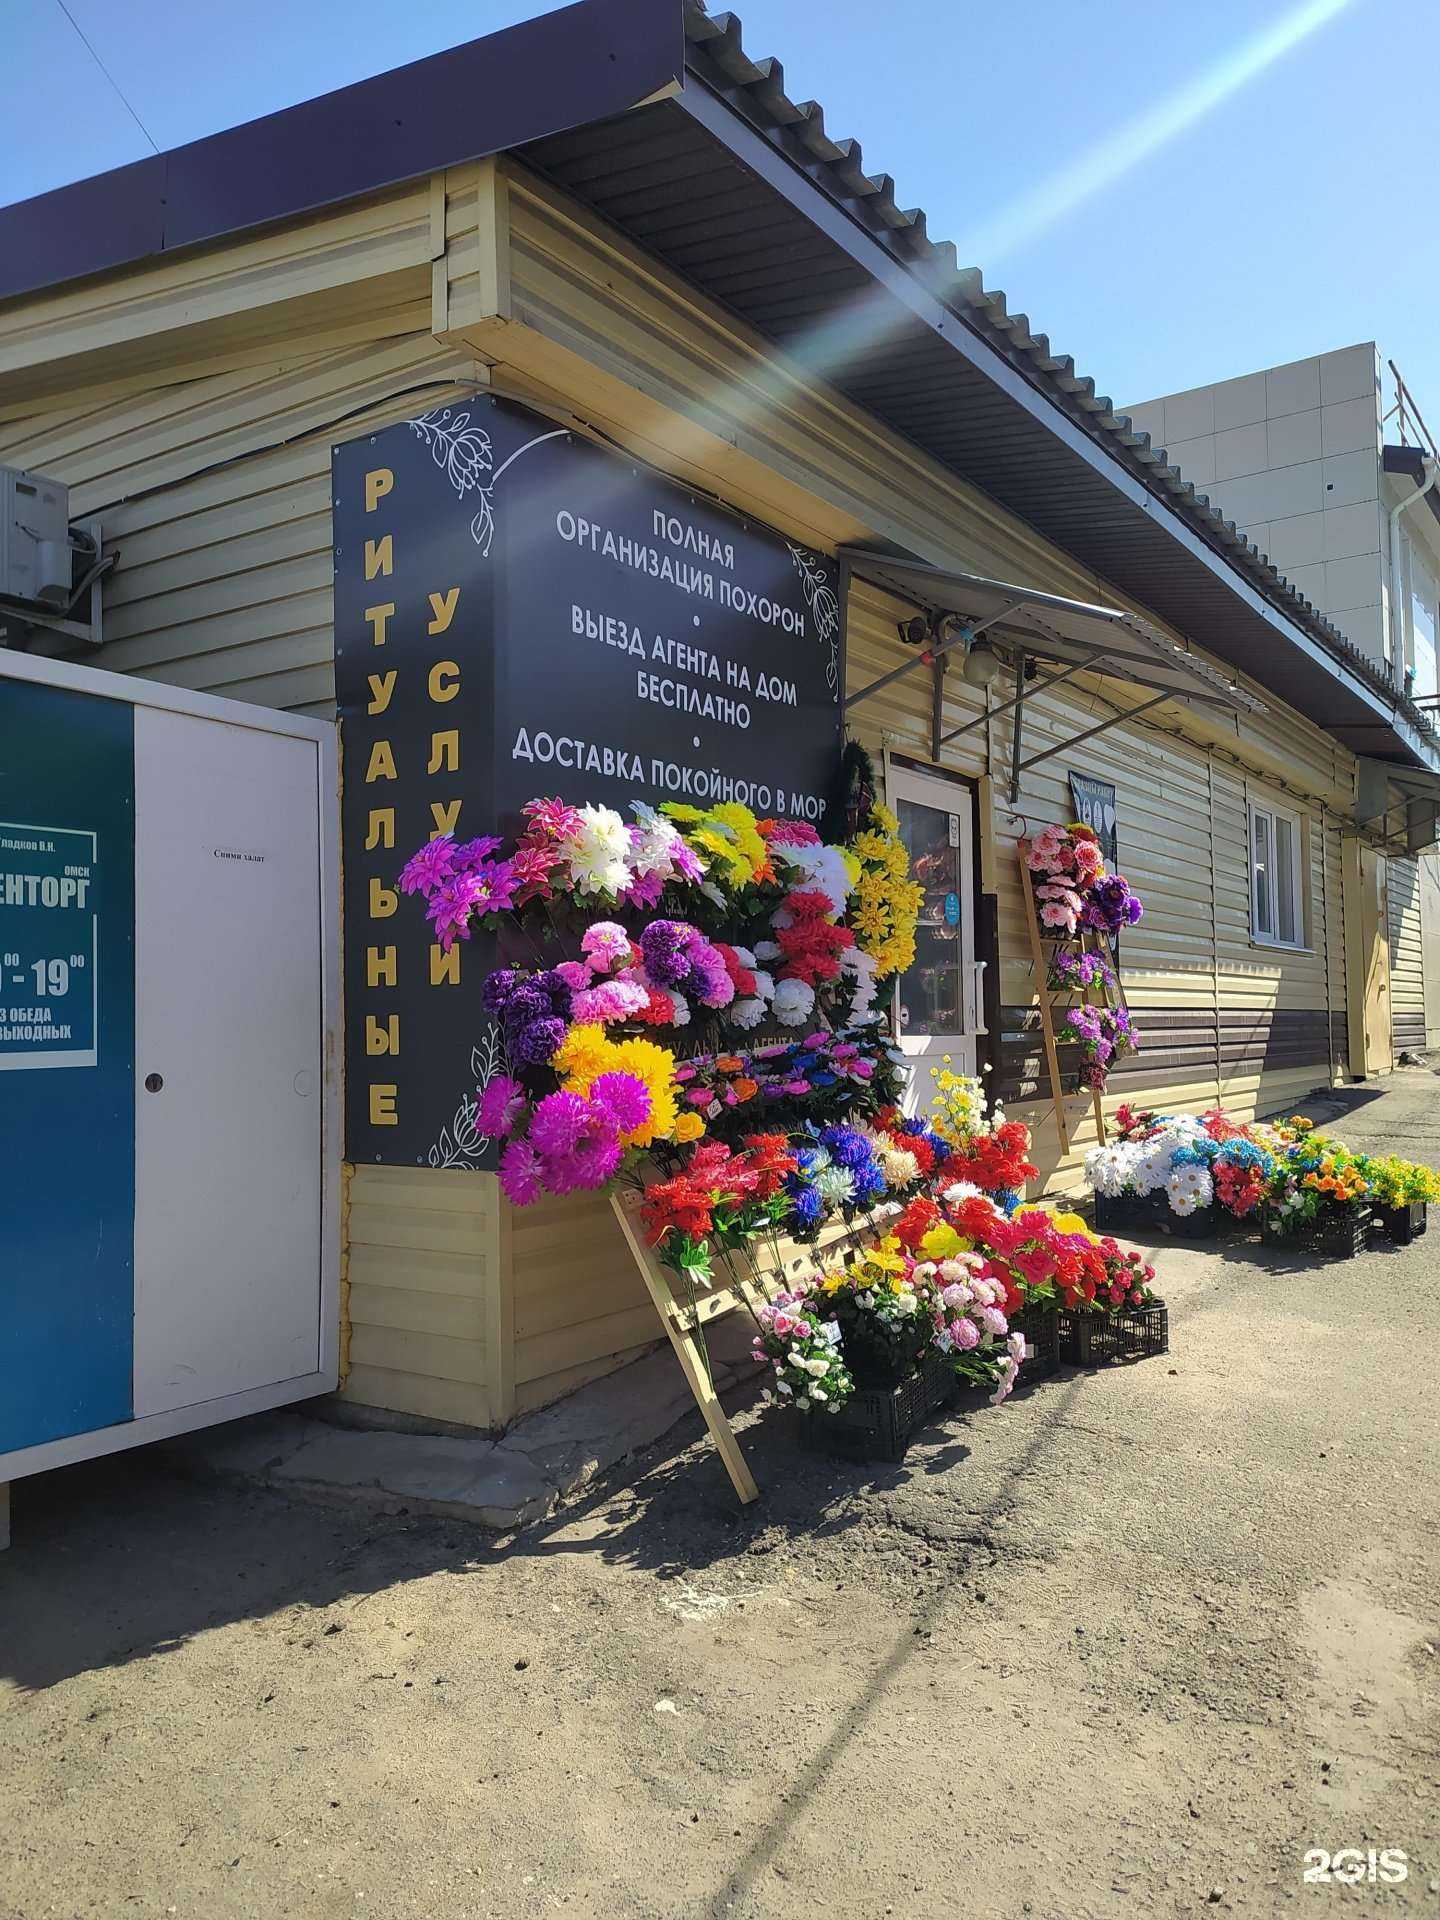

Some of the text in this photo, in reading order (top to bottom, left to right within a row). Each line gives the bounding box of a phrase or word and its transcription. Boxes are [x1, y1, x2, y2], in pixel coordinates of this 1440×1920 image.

[556, 510, 805, 637] ОРГАНИЗАЦИЯ ПОХОРОН
[653, 509, 735, 570] ПОЛНАЯ
[571, 604, 798, 706] ВЫЕЗД АГЕНТА НА ДОМ
[637, 670, 752, 729] БЕСПЛАТНО
[364, 468, 400, 1126] РИТУАЛЬНЫЕ
[427, 587, 463, 986] УСЛУИ
[512, 727, 827, 821] ДОСТАВКА ПОКОЙНОГО В МОР
[64, 865, 90, 878] ОМСК
[9, 1007, 52, 1025] ОБЕДА
